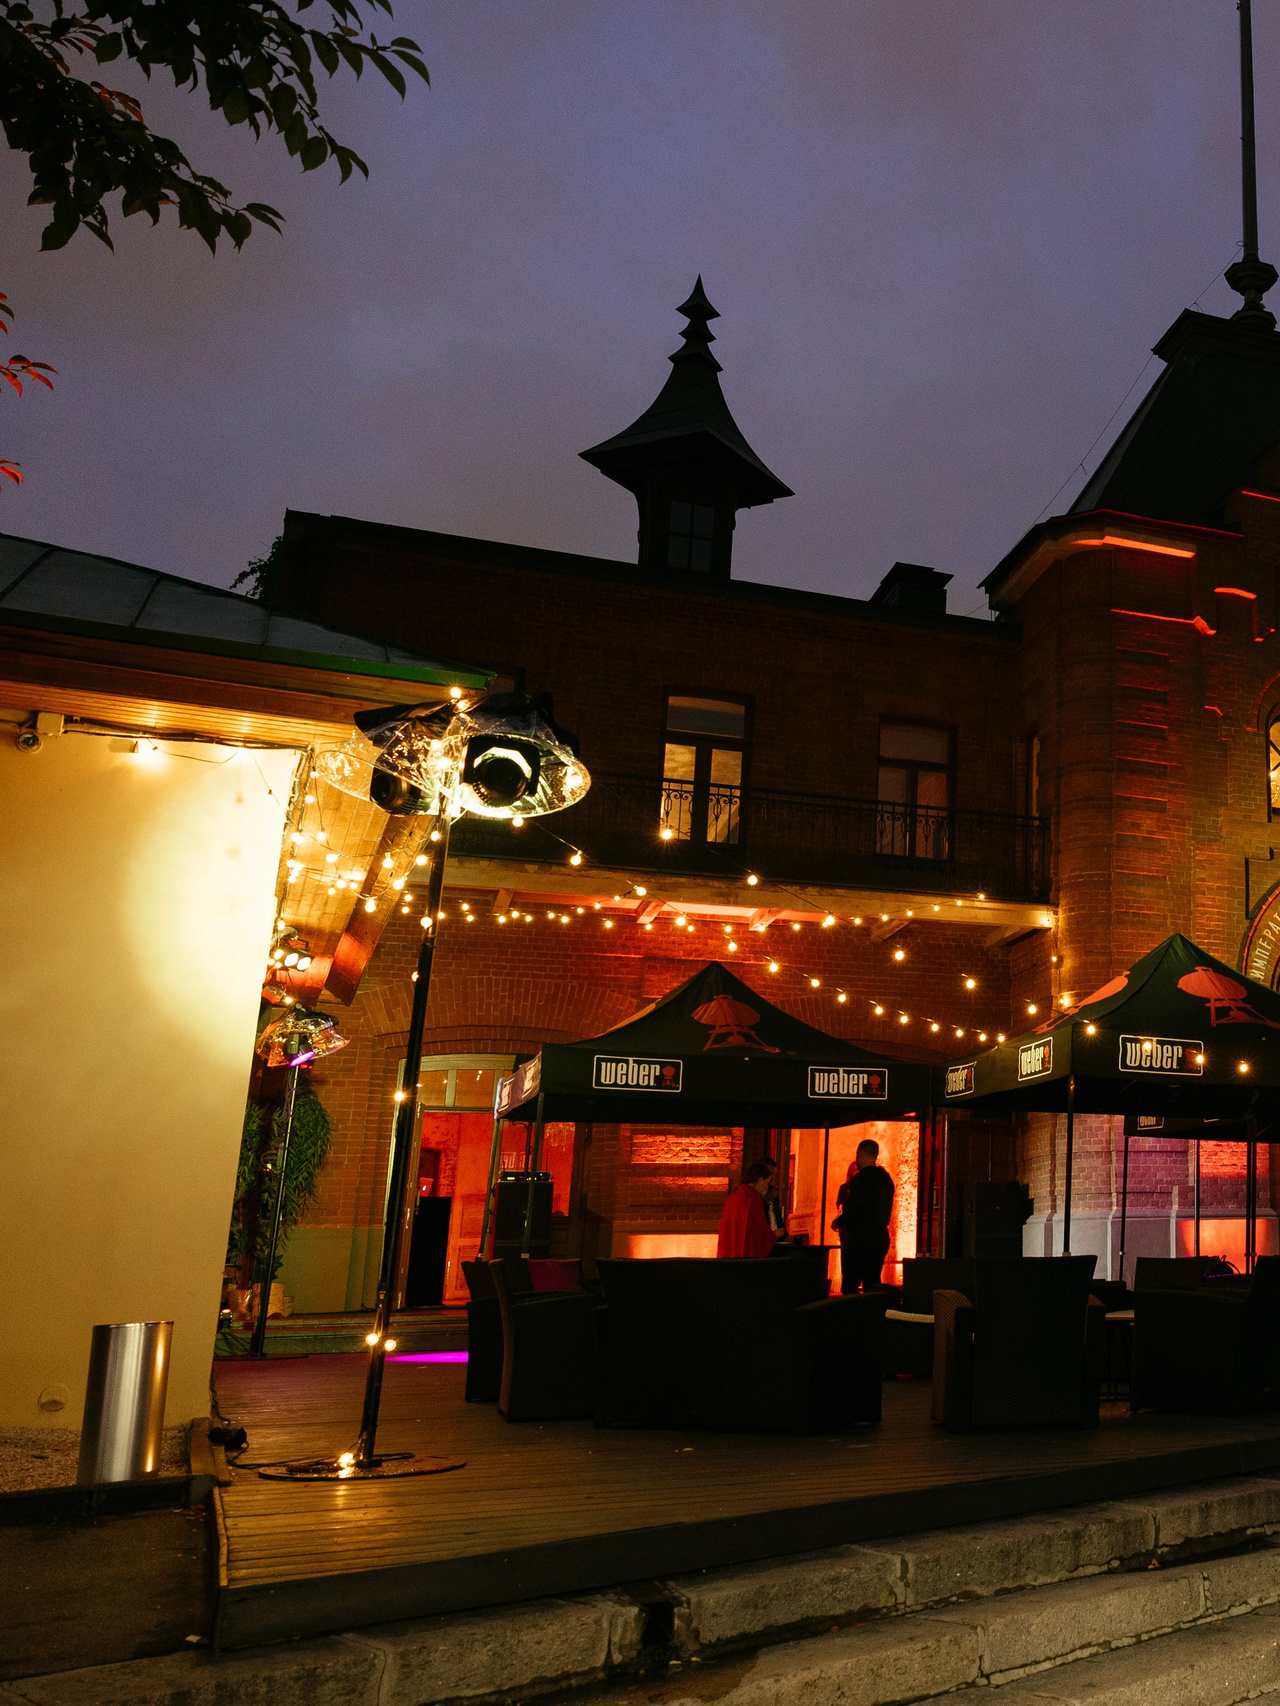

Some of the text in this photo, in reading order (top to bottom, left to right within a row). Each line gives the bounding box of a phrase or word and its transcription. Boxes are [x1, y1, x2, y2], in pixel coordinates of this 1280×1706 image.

[1126, 1038, 1183, 1070] weber
[600, 1058, 661, 1087] weber
[815, 1068, 868, 1095] weber
